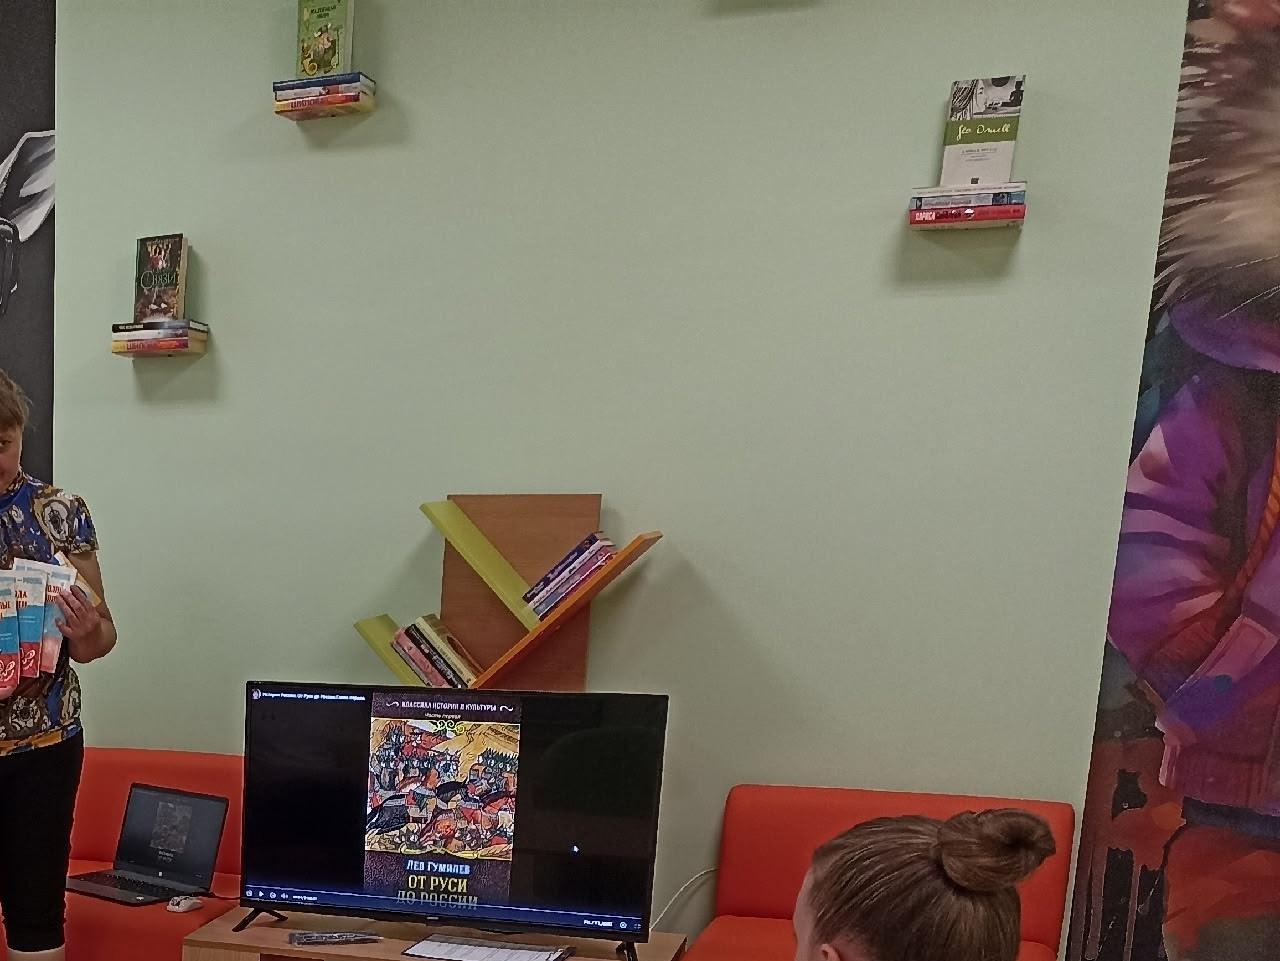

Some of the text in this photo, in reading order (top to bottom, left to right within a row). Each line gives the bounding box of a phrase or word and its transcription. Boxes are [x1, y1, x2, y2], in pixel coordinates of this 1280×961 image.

[465, 703, 497, 711] КУЛЬТУРЫ
[406, 860, 425, 871] ЛЕВ
[408, 875, 468, 893] ОТ РУСИ
[396, 890, 479, 910] ДО РОССИИ
